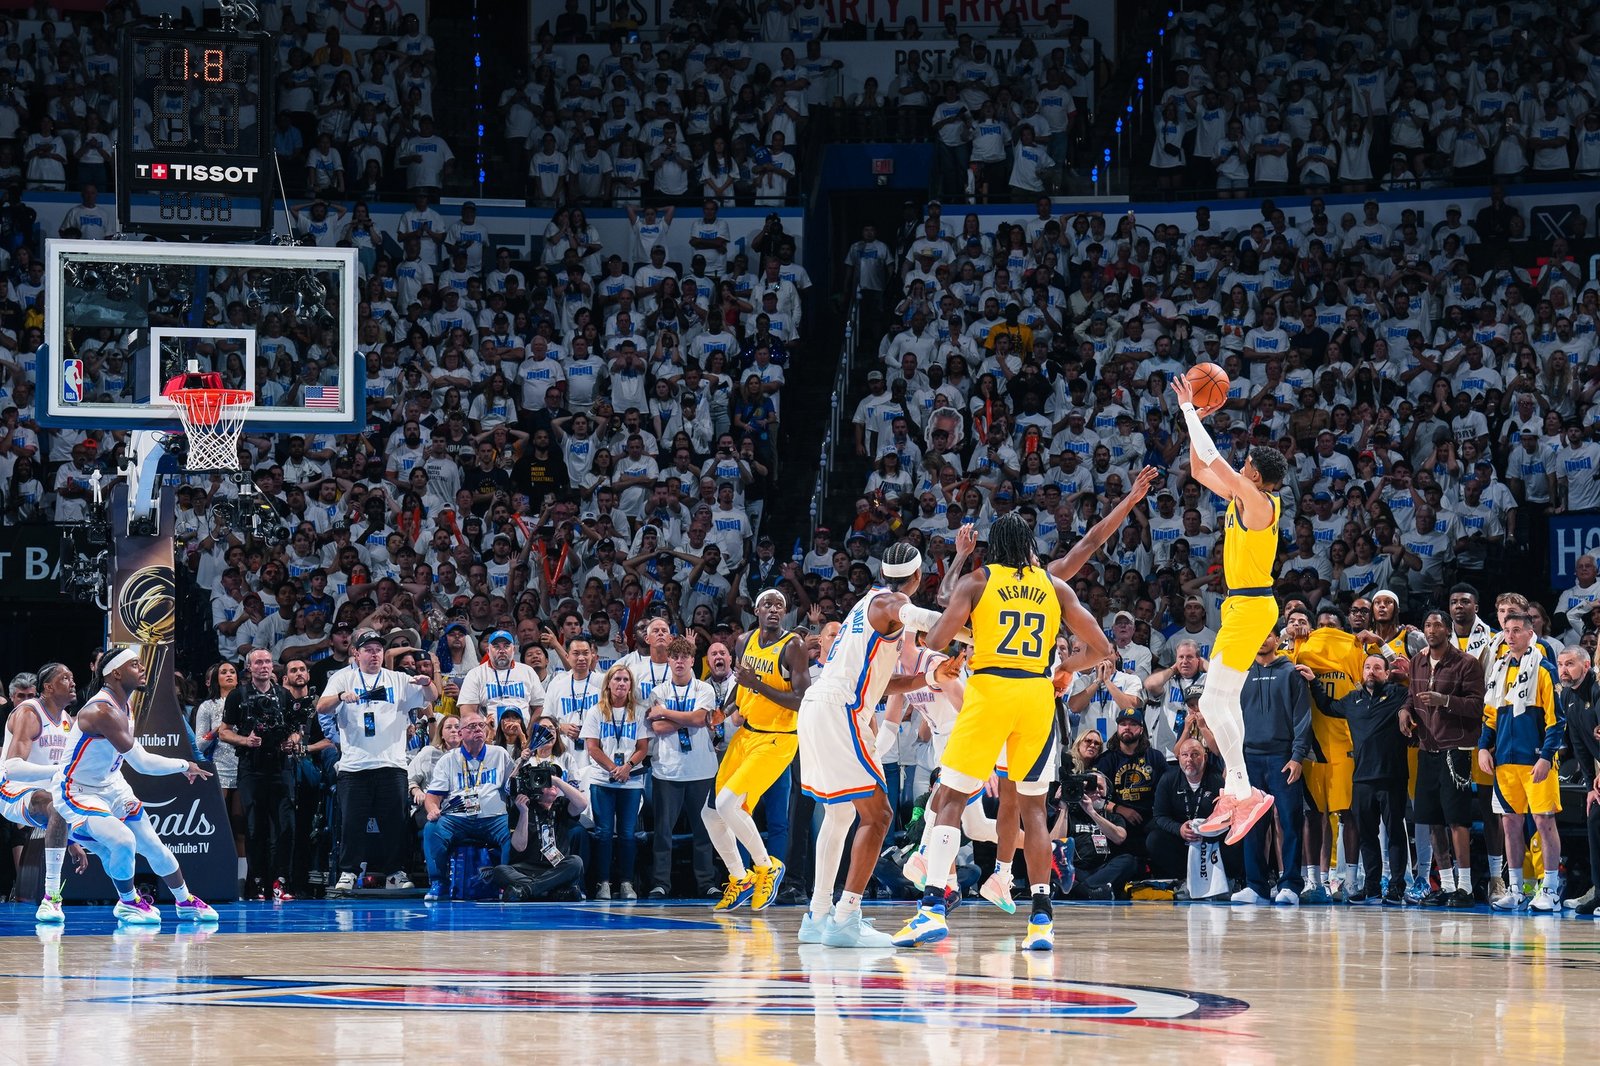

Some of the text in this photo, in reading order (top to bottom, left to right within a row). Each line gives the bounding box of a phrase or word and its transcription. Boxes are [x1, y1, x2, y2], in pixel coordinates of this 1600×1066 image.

[183, 48, 224, 82] 1.8
[171, 164, 259, 184] TISSOT
[1521, 461, 1546, 476] THUNDER
[1565, 457, 1591, 472] THUNDER
[716, 520, 741, 531] THUNDER
[1153, 529, 1179, 541] THUNDER
[997, 585, 1047, 605] NESMITH
[996, 610, 1046, 658] 23
[486, 682, 525, 699] THUNDER
[561, 694, 598, 716] THUNDER
[166, 734, 180, 747] TV
[198, 842, 210, 854] TV
